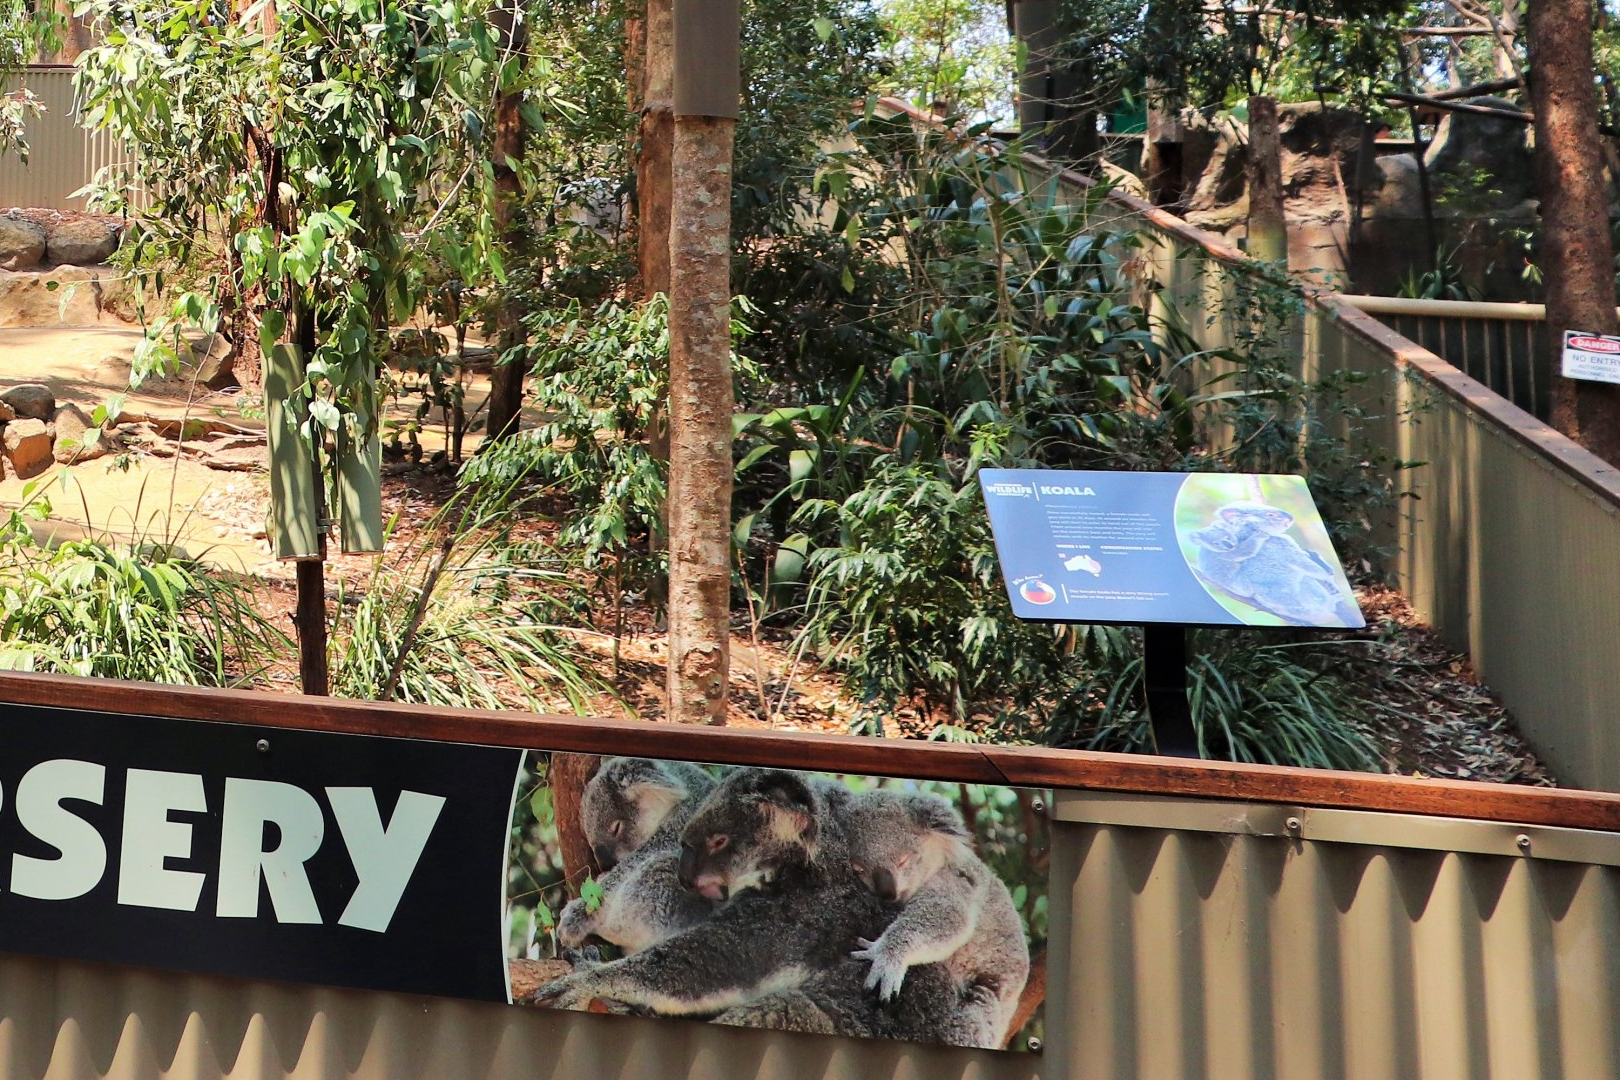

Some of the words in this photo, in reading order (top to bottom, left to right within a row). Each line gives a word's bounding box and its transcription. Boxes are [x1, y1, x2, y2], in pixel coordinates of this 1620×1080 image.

[1573, 354, 1586, 362] NO
[986, 485, 1032, 494] WILDLIFE
[1040, 486, 1096, 496] KOALA
